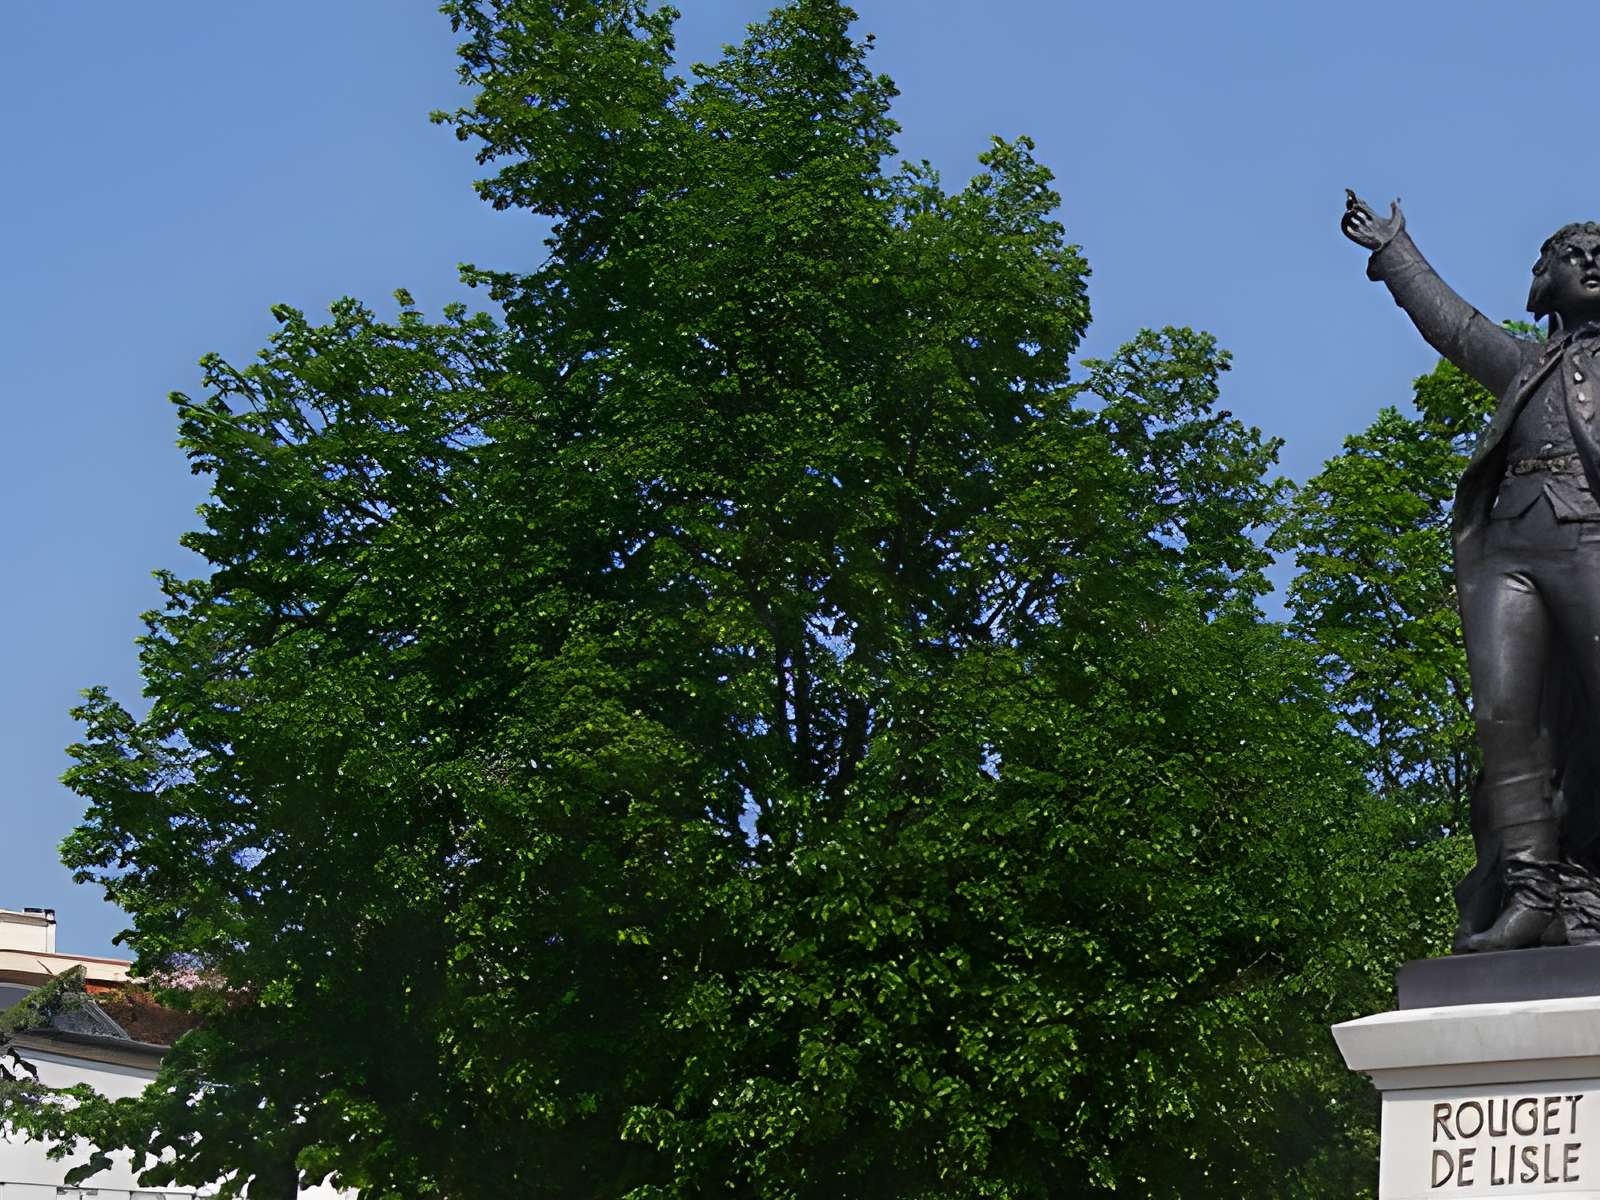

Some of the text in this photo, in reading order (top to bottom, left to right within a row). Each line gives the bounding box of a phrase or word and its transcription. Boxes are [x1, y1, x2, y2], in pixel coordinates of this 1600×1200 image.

[1432, 1094, 1584, 1142] ROUGET
[1431, 1142, 1582, 1189] DE LISLE
